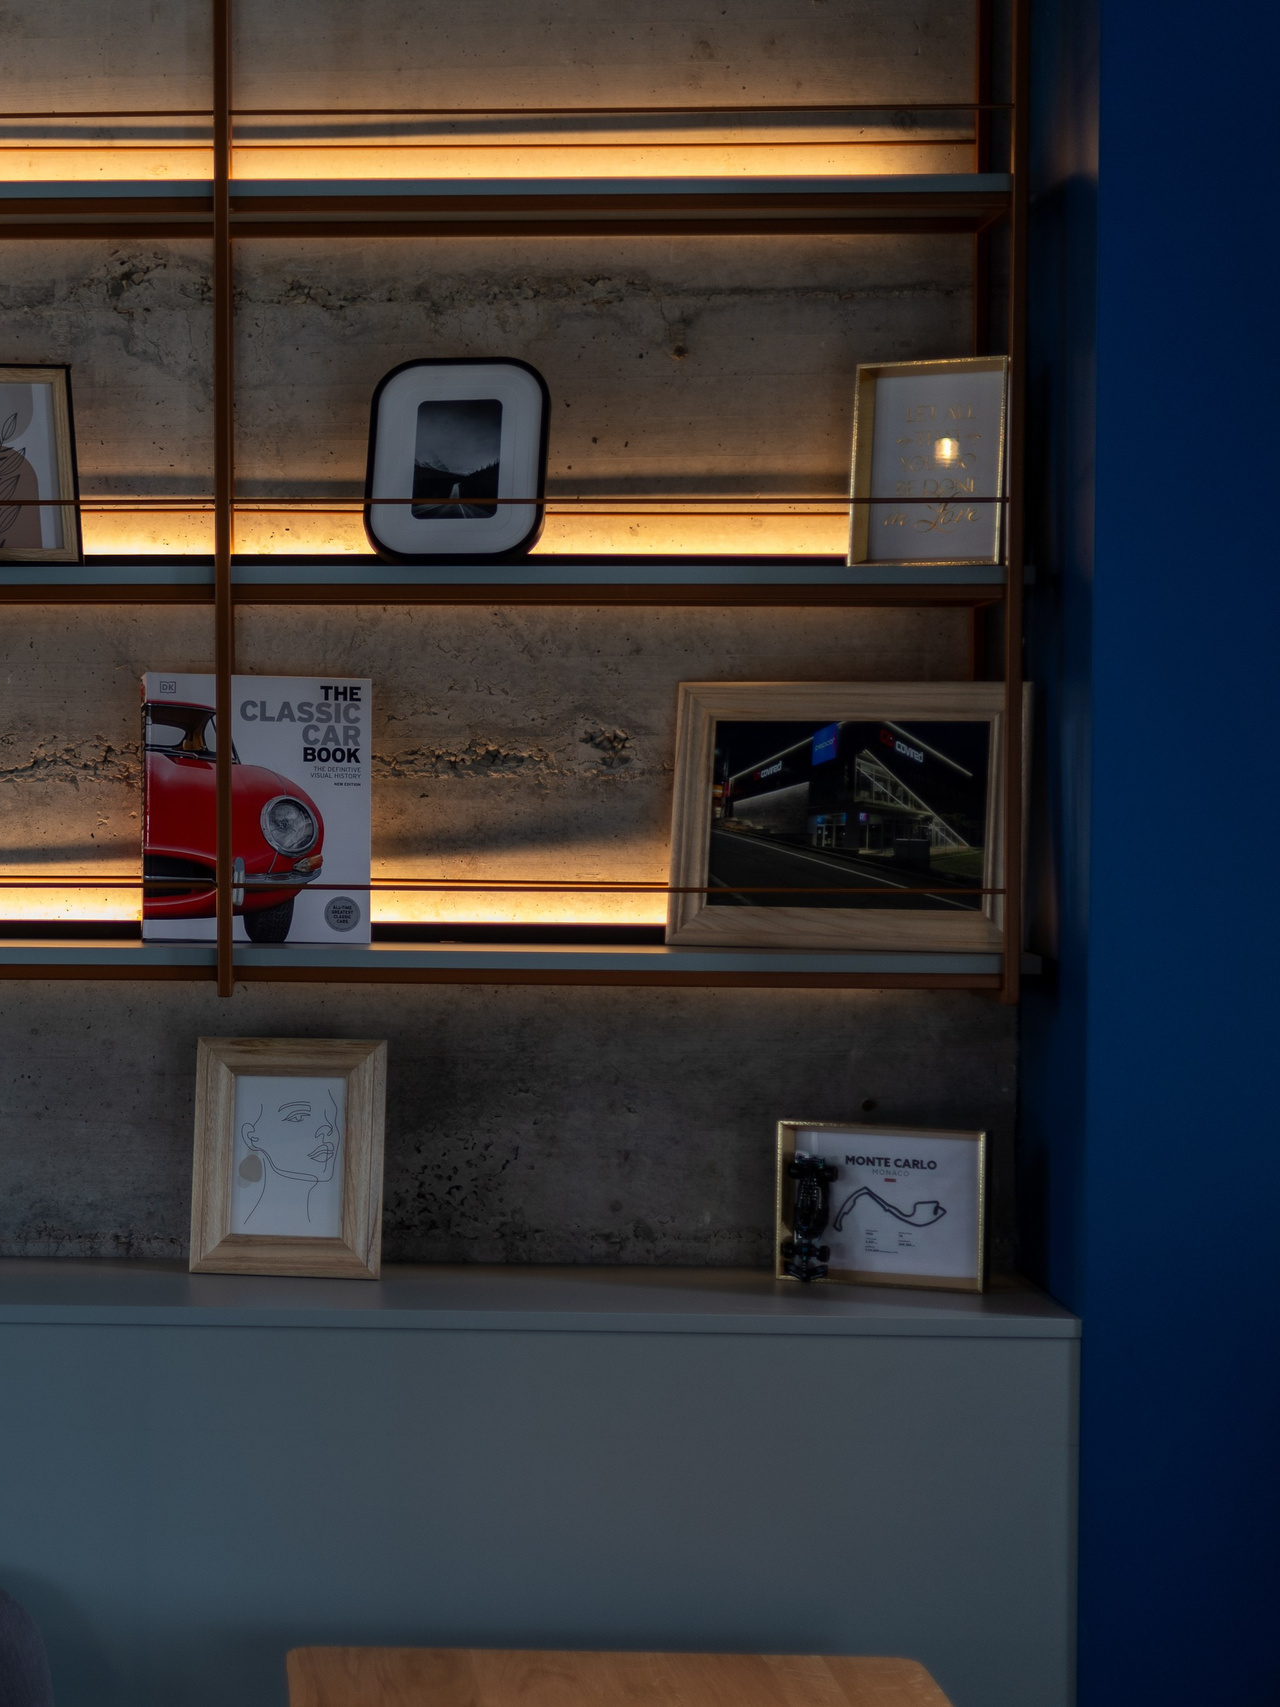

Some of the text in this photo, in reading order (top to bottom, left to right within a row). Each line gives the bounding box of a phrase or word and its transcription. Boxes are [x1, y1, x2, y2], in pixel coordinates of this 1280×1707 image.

[906, 403, 978, 423] LET ALL
[884, 491, 982, 533] in Love
[320, 685, 362, 702] THE
[240, 699, 362, 725] CLASSIC
[302, 724, 362, 747] CAR
[303, 746, 362, 764] BOOK
[845, 1155, 938, 1171] MONTE CARLO
[872, 1168, 910, 1177] MONACO
